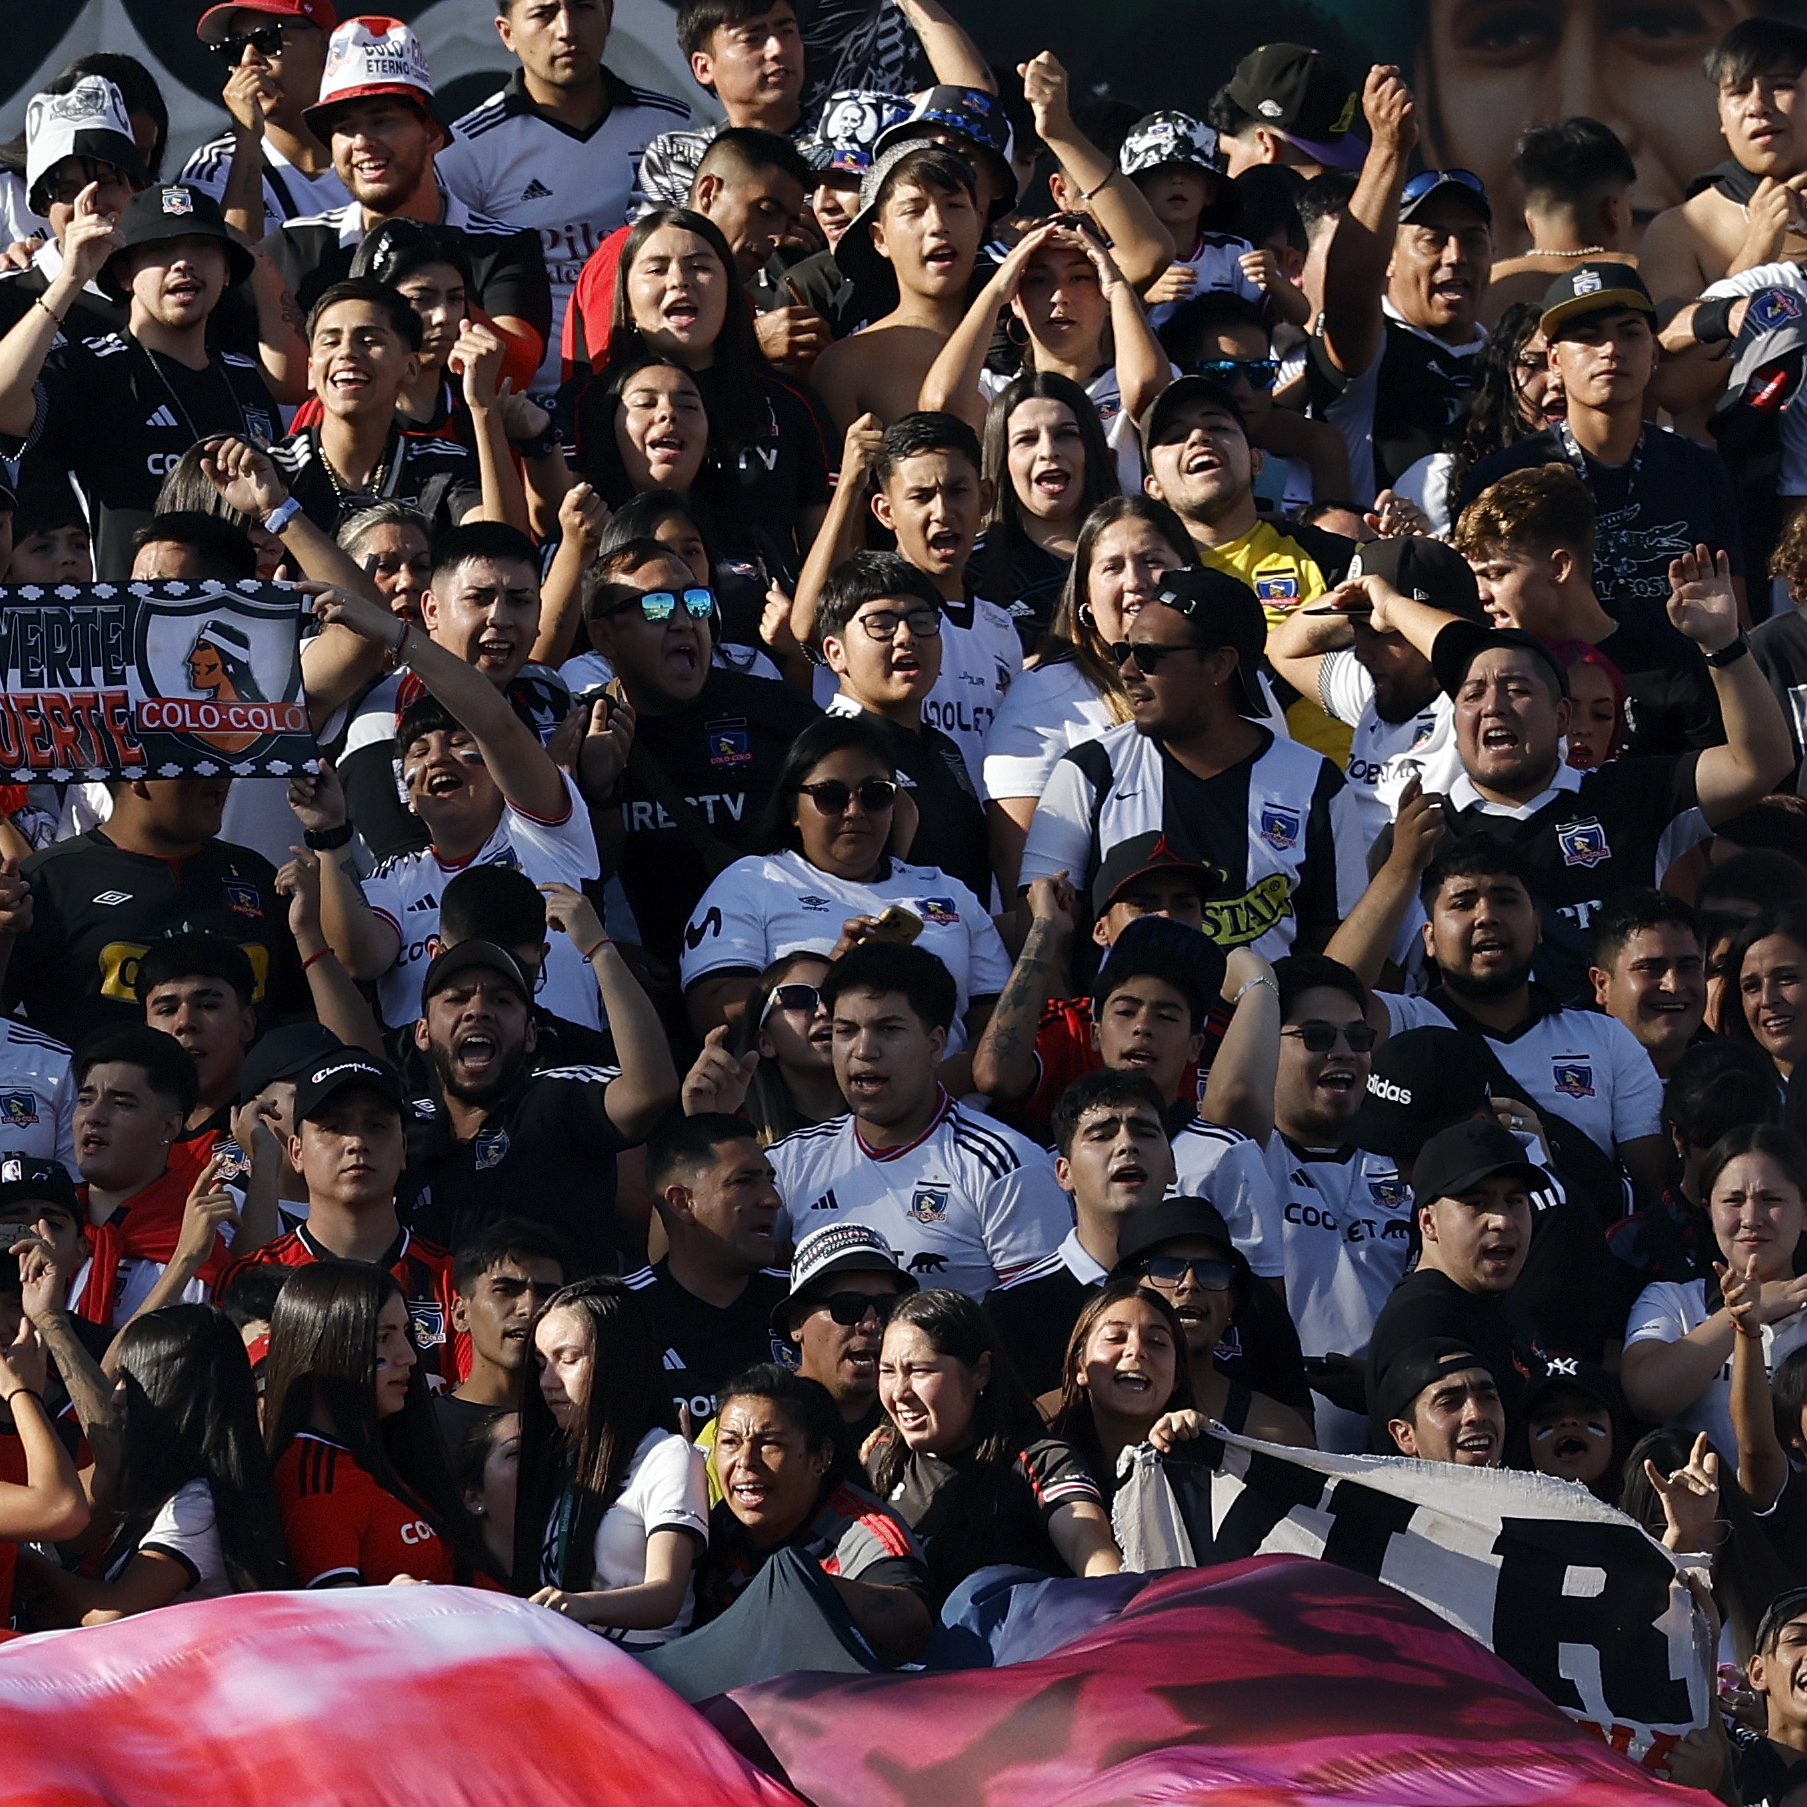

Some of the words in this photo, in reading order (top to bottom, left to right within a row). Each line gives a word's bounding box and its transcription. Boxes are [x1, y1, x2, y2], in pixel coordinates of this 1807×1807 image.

[366, 59, 410, 76] ETERNO
[140, 700, 307, 733] COLO-COLO
[310, 1061, 384, 1085] Champion
